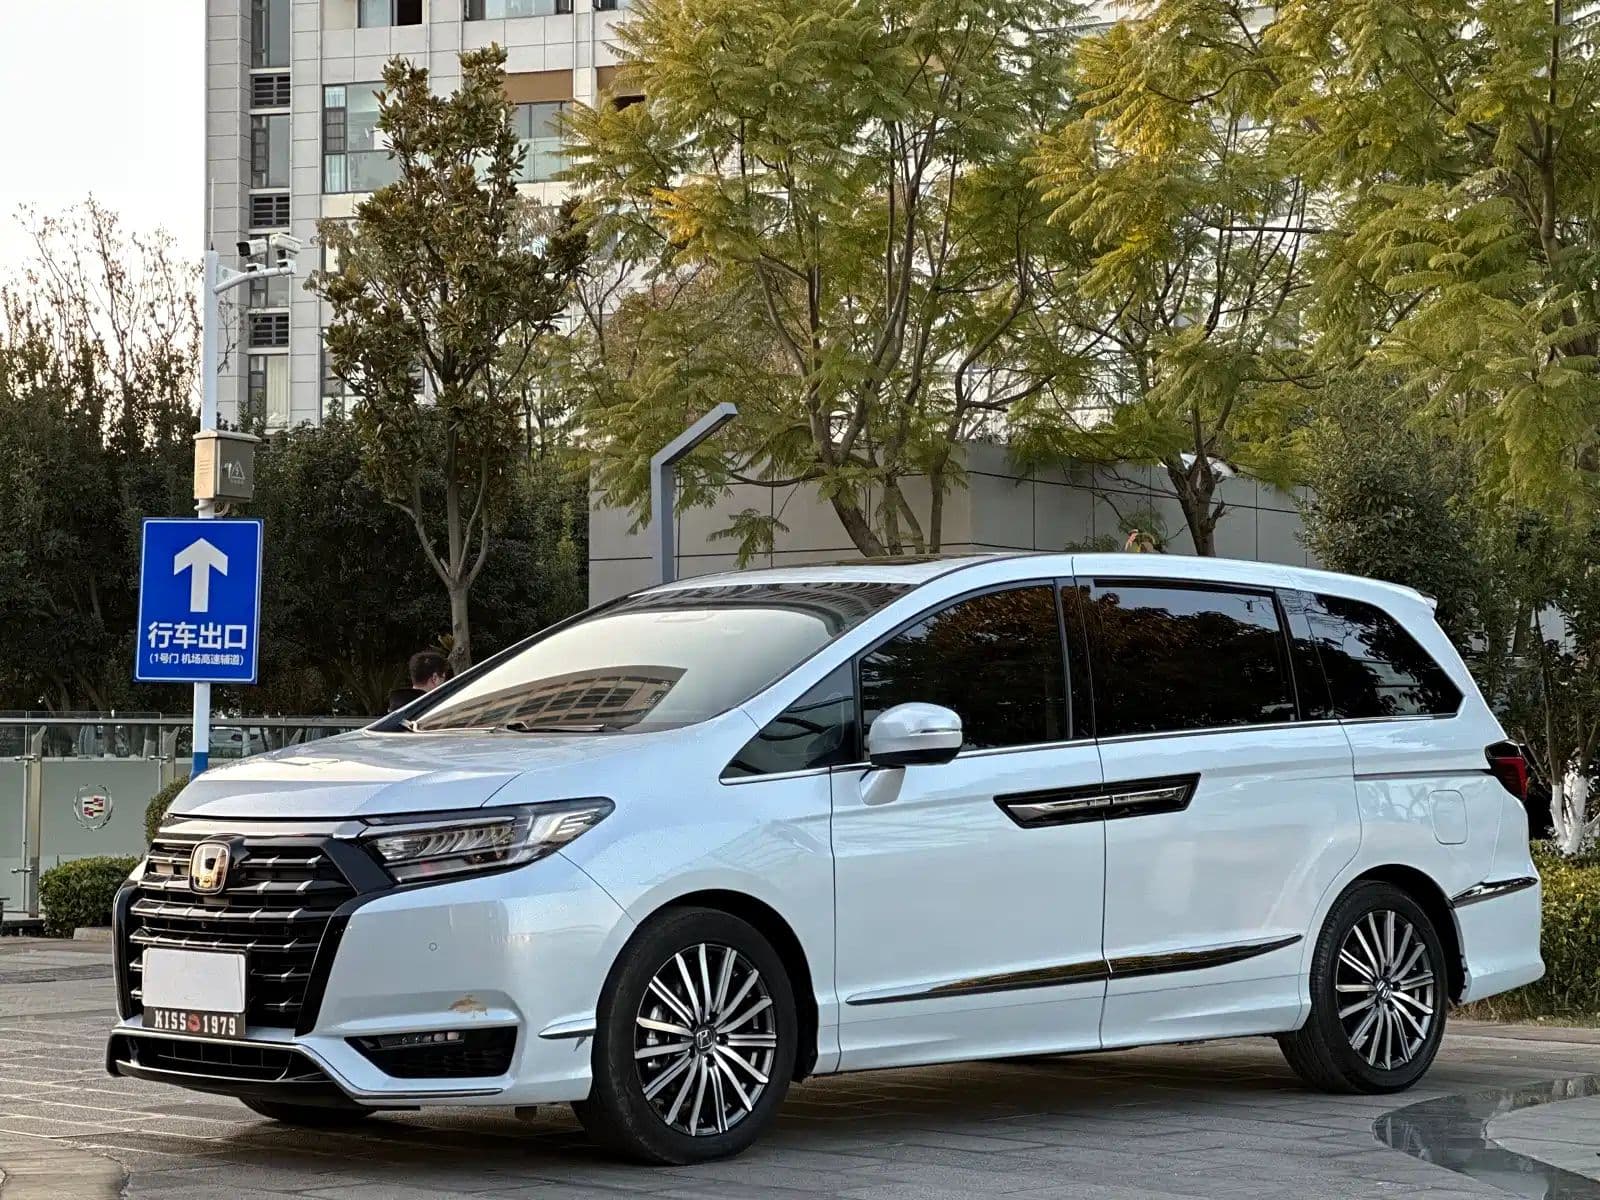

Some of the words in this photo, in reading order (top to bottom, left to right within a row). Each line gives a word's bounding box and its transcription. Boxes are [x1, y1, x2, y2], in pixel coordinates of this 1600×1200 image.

[148, 621, 247, 649] 行车出口
[154, 1009, 187, 1031] KISS
[203, 1014, 236, 1036] 1979
